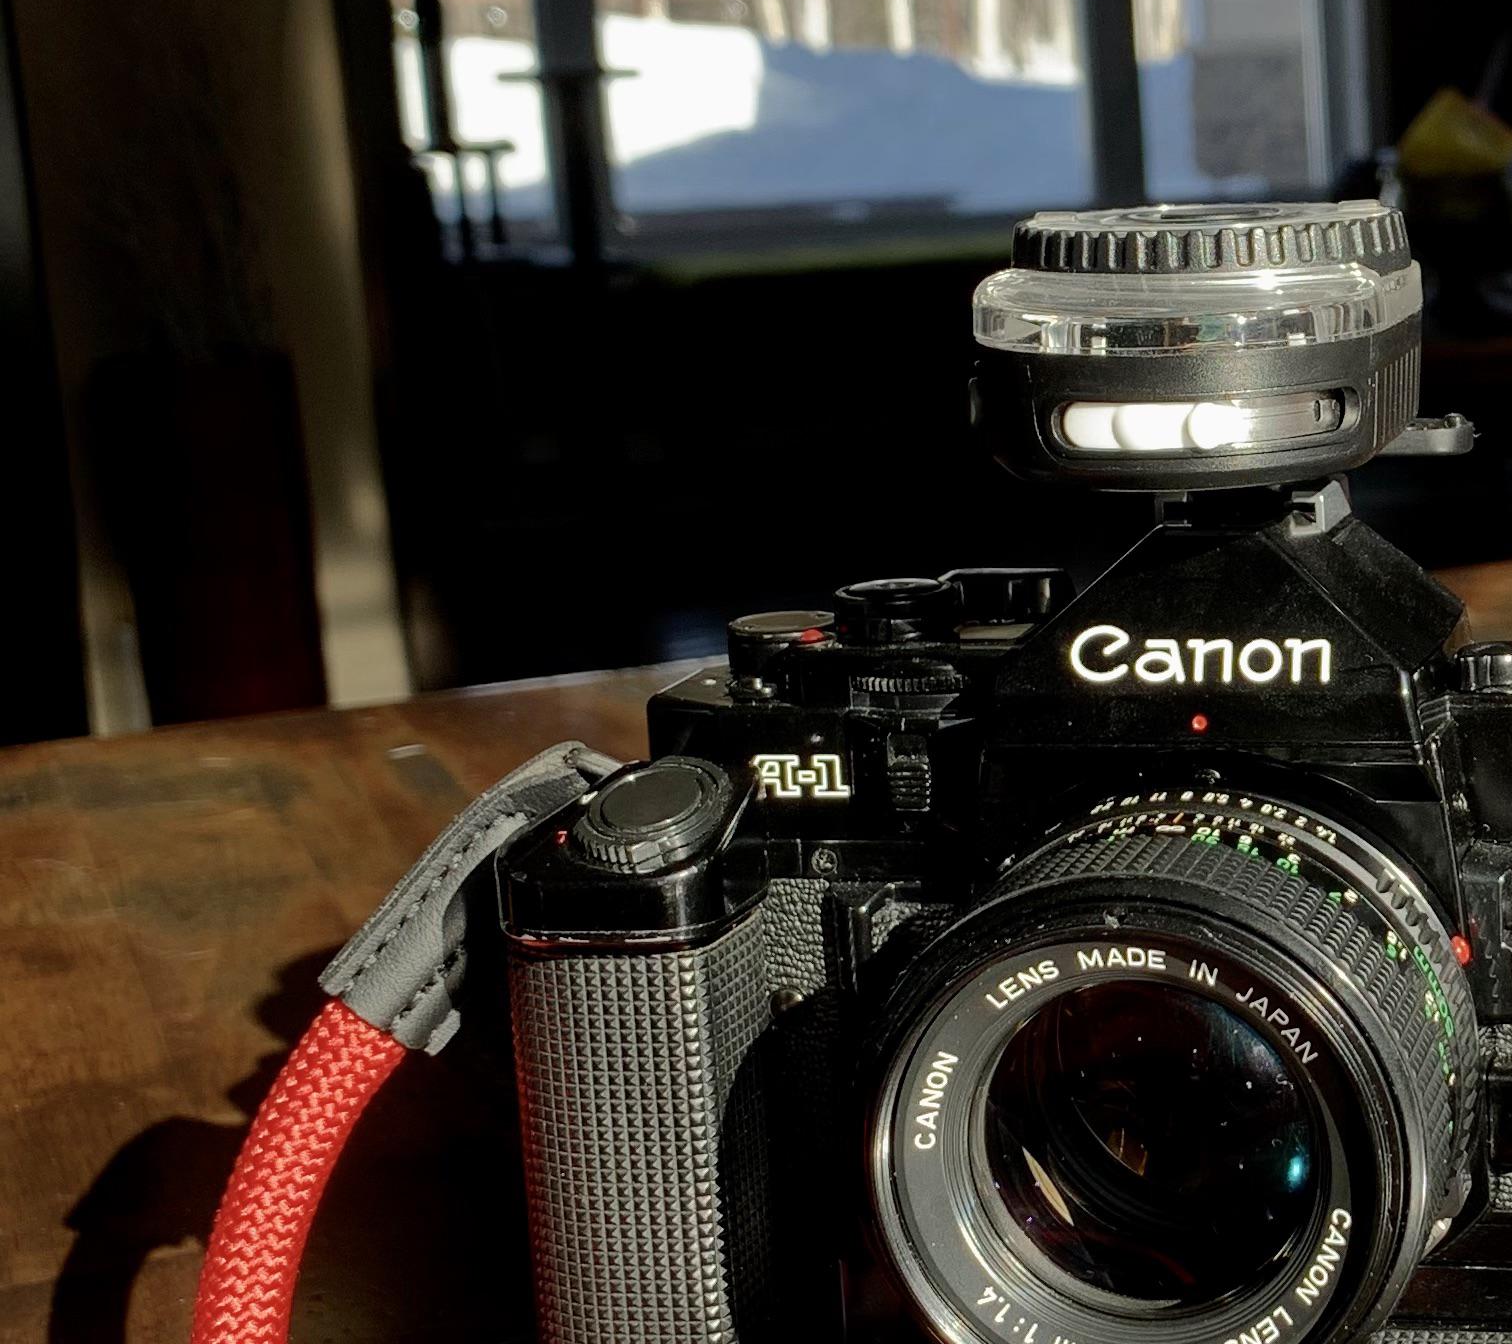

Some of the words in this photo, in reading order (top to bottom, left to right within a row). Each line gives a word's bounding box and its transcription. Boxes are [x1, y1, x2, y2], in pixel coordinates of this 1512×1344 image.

[1069, 624, 1332, 685] Canon
[750, 752, 853, 800] A-1
[985, 960, 1061, 1010] LENS
[1077, 947, 1167, 971] MADE
[1189, 959, 1220, 987] IN
[1236, 987, 1319, 1065] JAPAN
[914, 1050, 960, 1151] CANON
[1296, 1207, 1353, 1307] CANON
[975, 1285, 1040, 1344] 1:1.4
